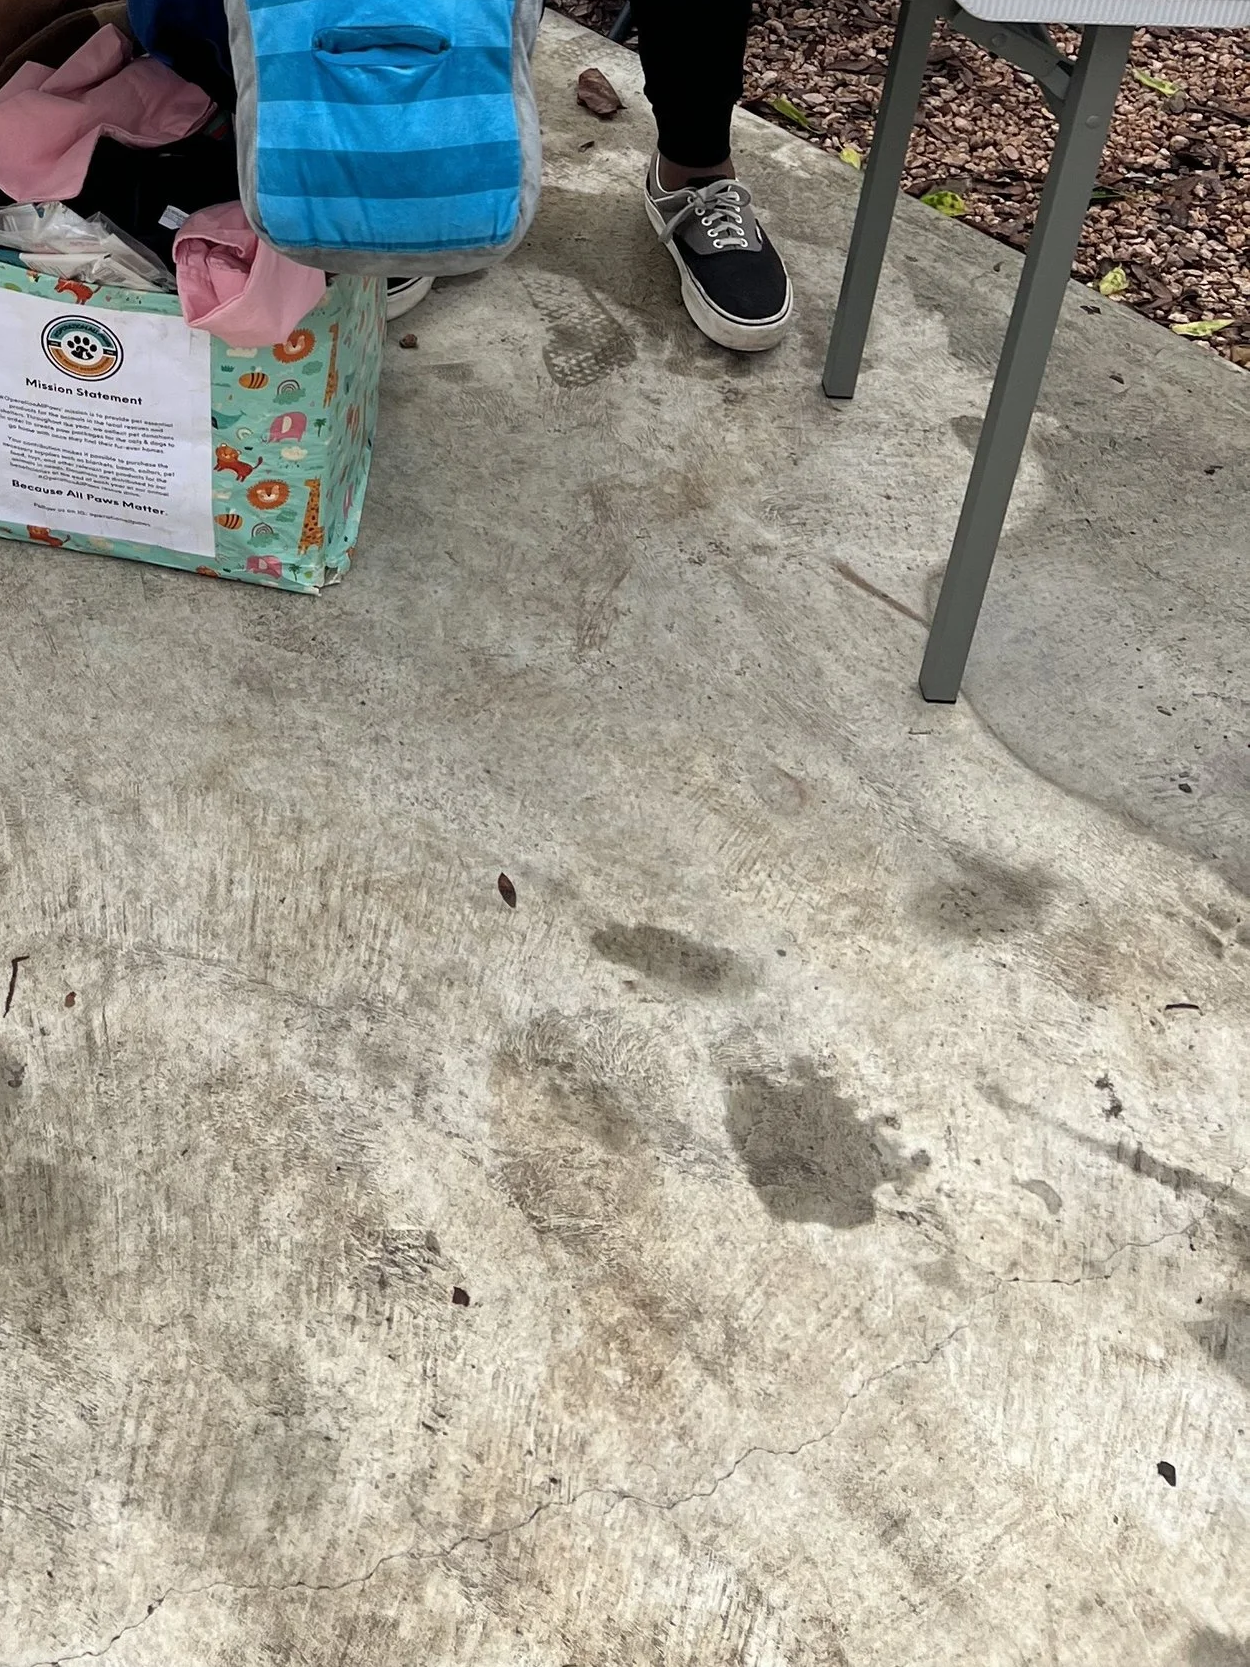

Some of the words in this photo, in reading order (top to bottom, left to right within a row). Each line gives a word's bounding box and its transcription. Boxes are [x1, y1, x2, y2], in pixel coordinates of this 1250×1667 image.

[25, 377, 72, 395] Mission
[76, 387, 142, 406] Statement
[11, 479, 63, 496] Because
[66, 488, 83, 499] All
[86, 492, 119, 506] Paws
